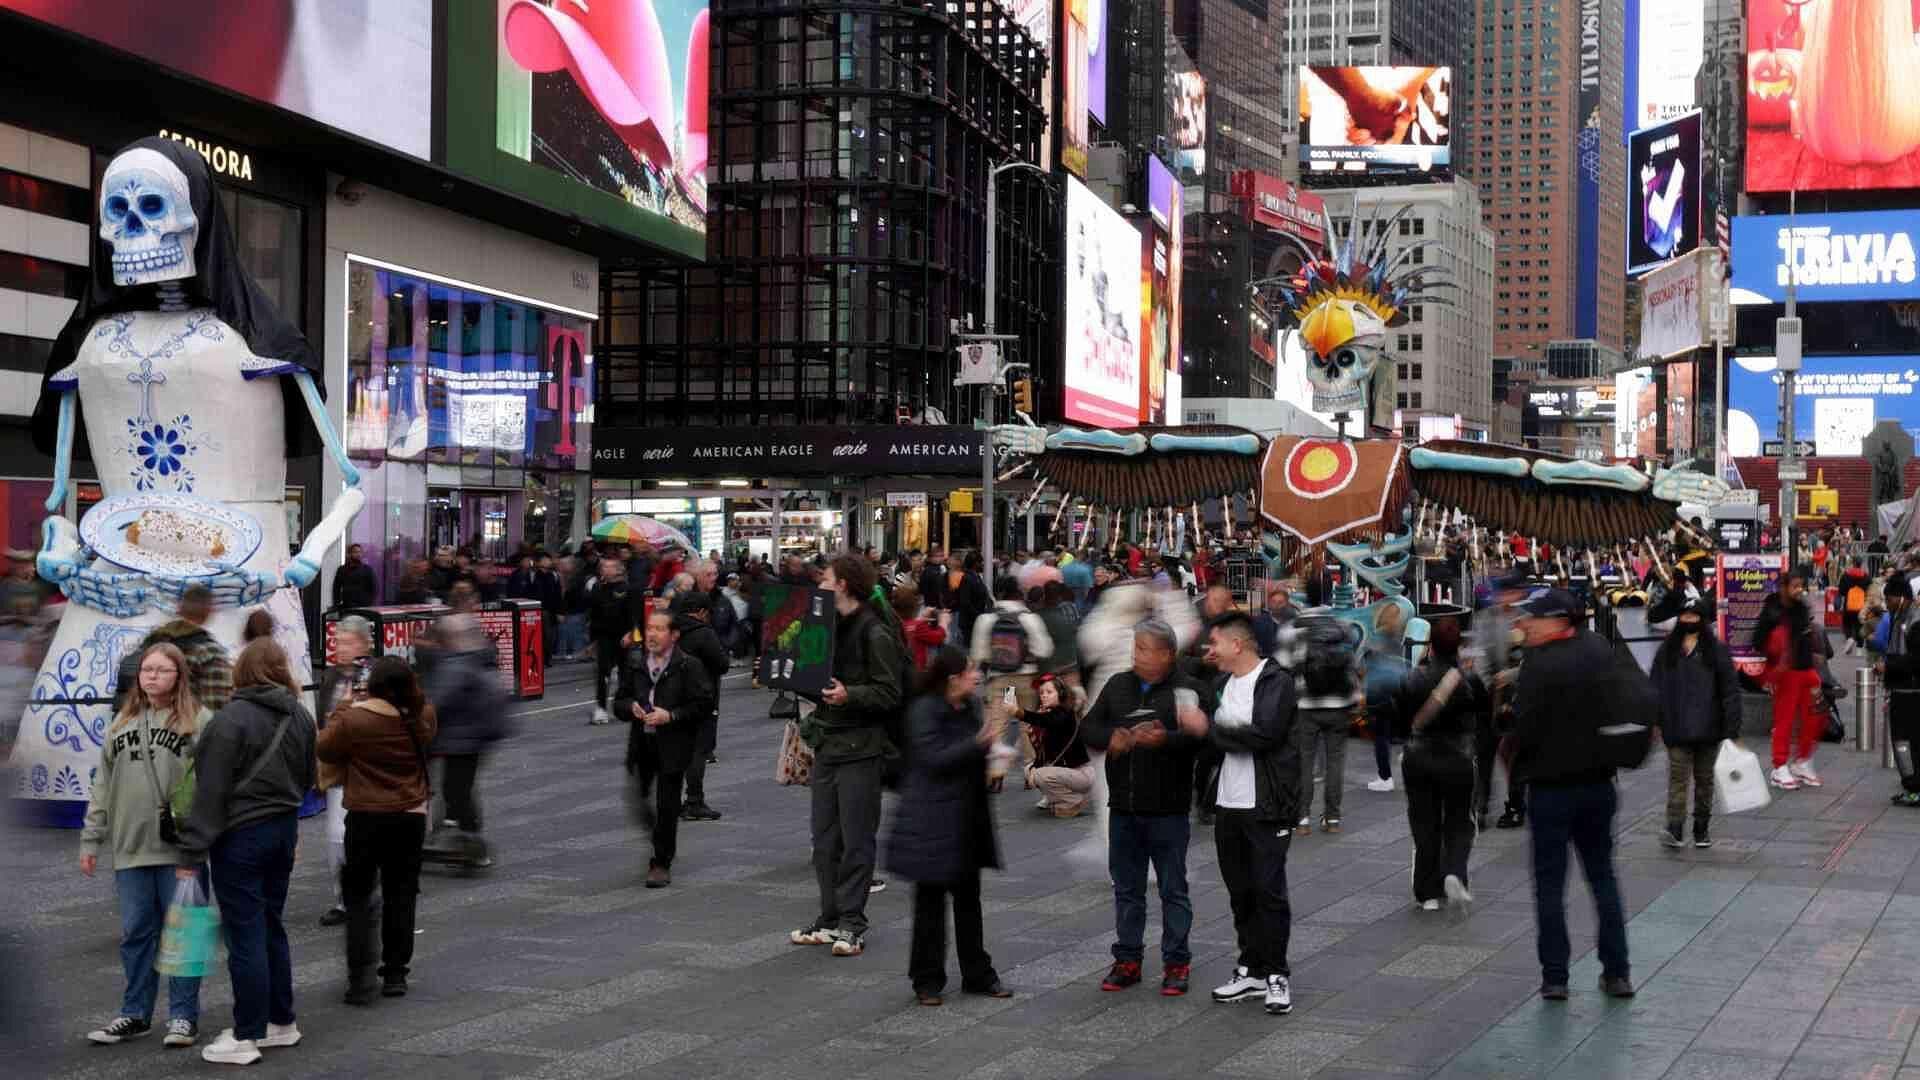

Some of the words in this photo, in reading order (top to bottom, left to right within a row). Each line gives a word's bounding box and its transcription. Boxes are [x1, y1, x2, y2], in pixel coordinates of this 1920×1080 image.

[1777, 232, 1916, 268] TRIVIA
[1776, 258, 1916, 286] MOMENTS
[547, 325, 585, 455] T
[692, 445, 764, 458] AMERICAN
[770, 444, 814, 456] EAGLE
[888, 443, 969, 456] AMERICAN
[112, 729, 141, 757] NEW
[150, 728, 187, 757] YORK
[130, 750, 156, 761] NC
